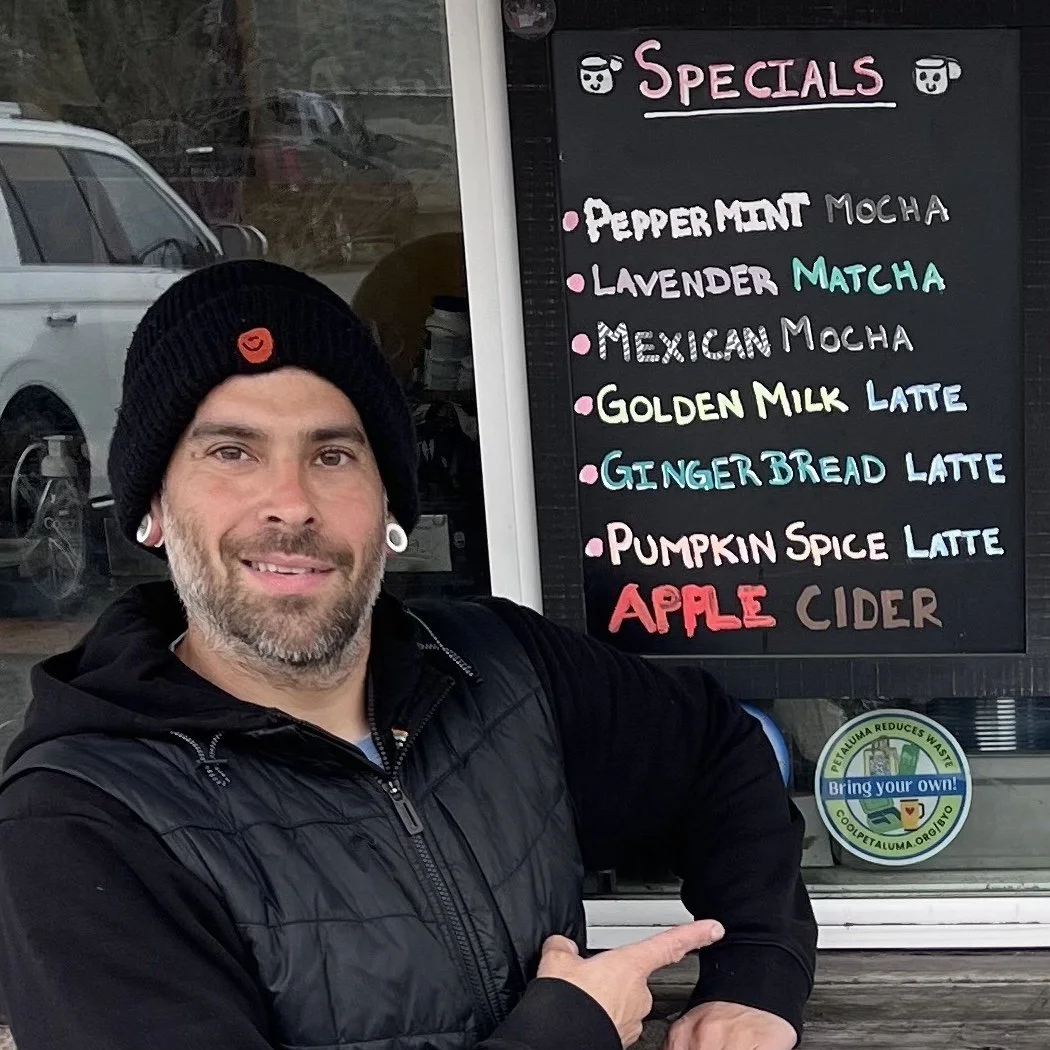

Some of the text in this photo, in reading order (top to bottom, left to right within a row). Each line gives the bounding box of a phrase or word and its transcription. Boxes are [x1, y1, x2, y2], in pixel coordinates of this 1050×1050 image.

[634, 39, 883, 105] SPECIALS
[583, 192, 950, 243] PEPPERMINT MOCHA
[591, 256, 946, 299] LAVENDER MATCHA
[597, 315, 914, 364] MEXICAN MOCHA
[597, 380, 967, 425] GOLDEN MILK LATTE
[601, 450, 1006, 491] GINGERBREAD LATTE
[606, 521, 1004, 569] PUMPKIN SPICE LATTE
[608, 583, 943, 638] APPLE CIDER
[831, 722, 954, 773] PETALUMA REDUCES WASTE
[828, 776, 957, 798] Bring your own!
[836, 805, 953, 851] COOLPETALUMA.ORG/BYO
